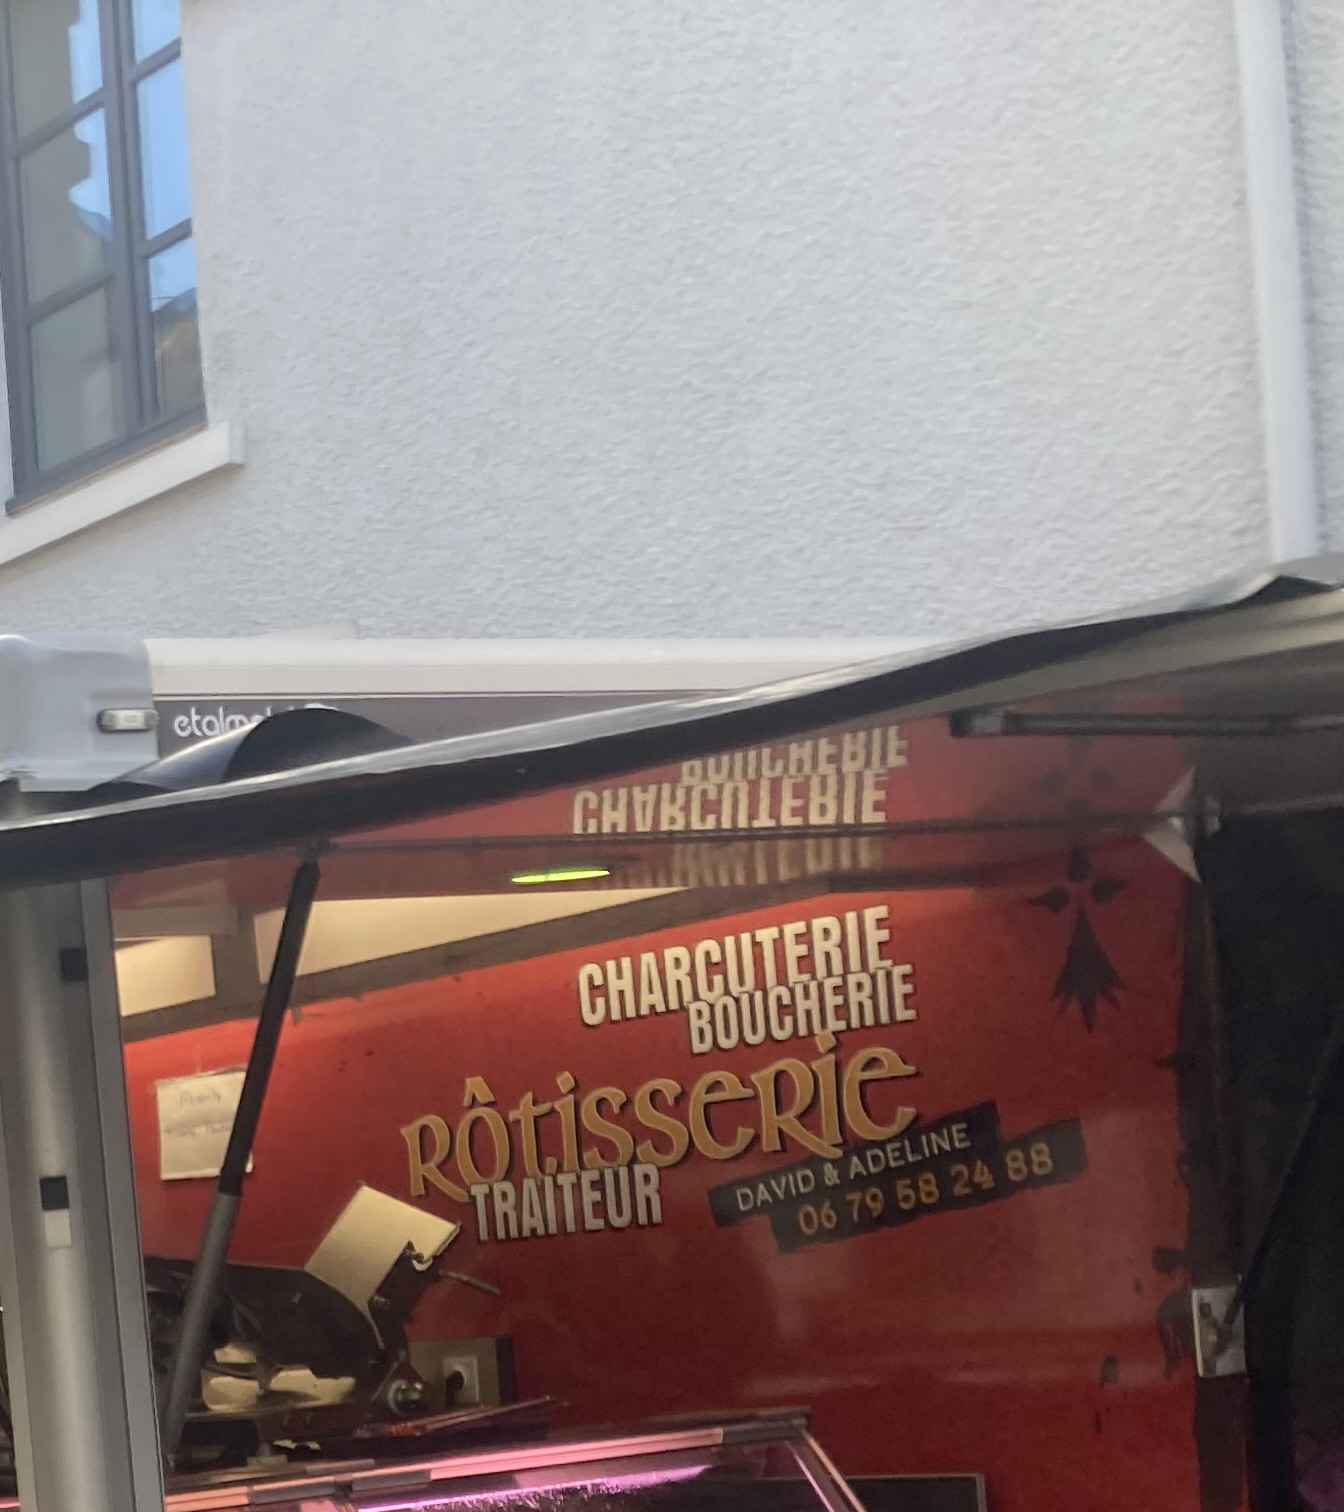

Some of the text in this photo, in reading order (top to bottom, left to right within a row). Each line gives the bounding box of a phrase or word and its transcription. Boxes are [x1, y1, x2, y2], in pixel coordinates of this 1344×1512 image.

[578, 904, 892, 1027] CHARCUTERIE
[688, 964, 917, 1054] BOUCHERIE
[470, 1163, 663, 1242] TRAITEUR
[736, 1123, 971, 1212] DAVID & ADELINE
[799, 1142, 1054, 1235] 06 79 58 24 88
